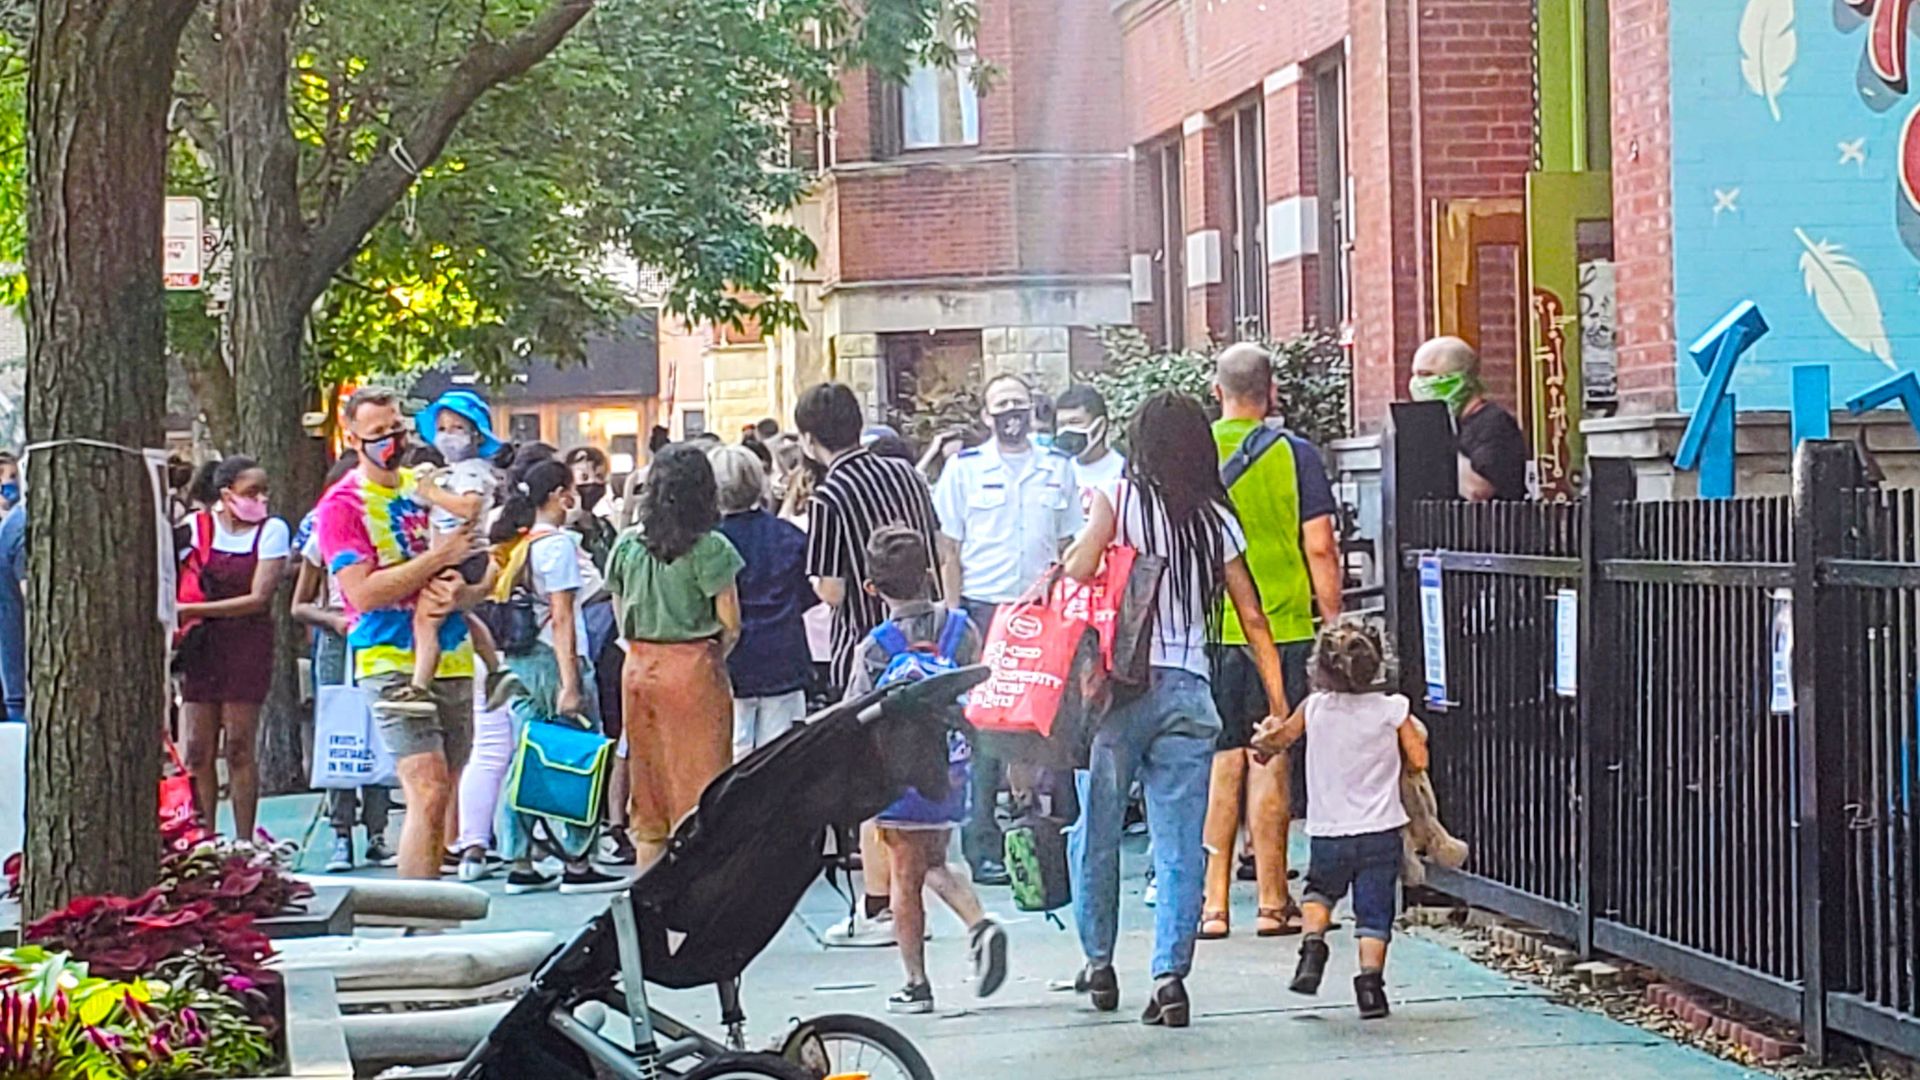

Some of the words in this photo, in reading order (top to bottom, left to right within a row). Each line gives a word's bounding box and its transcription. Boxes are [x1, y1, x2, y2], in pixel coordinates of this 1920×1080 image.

[163, 273, 193, 286] ONE
[328, 762, 336, 771] IN
[340, 761, 353, 772] THE
